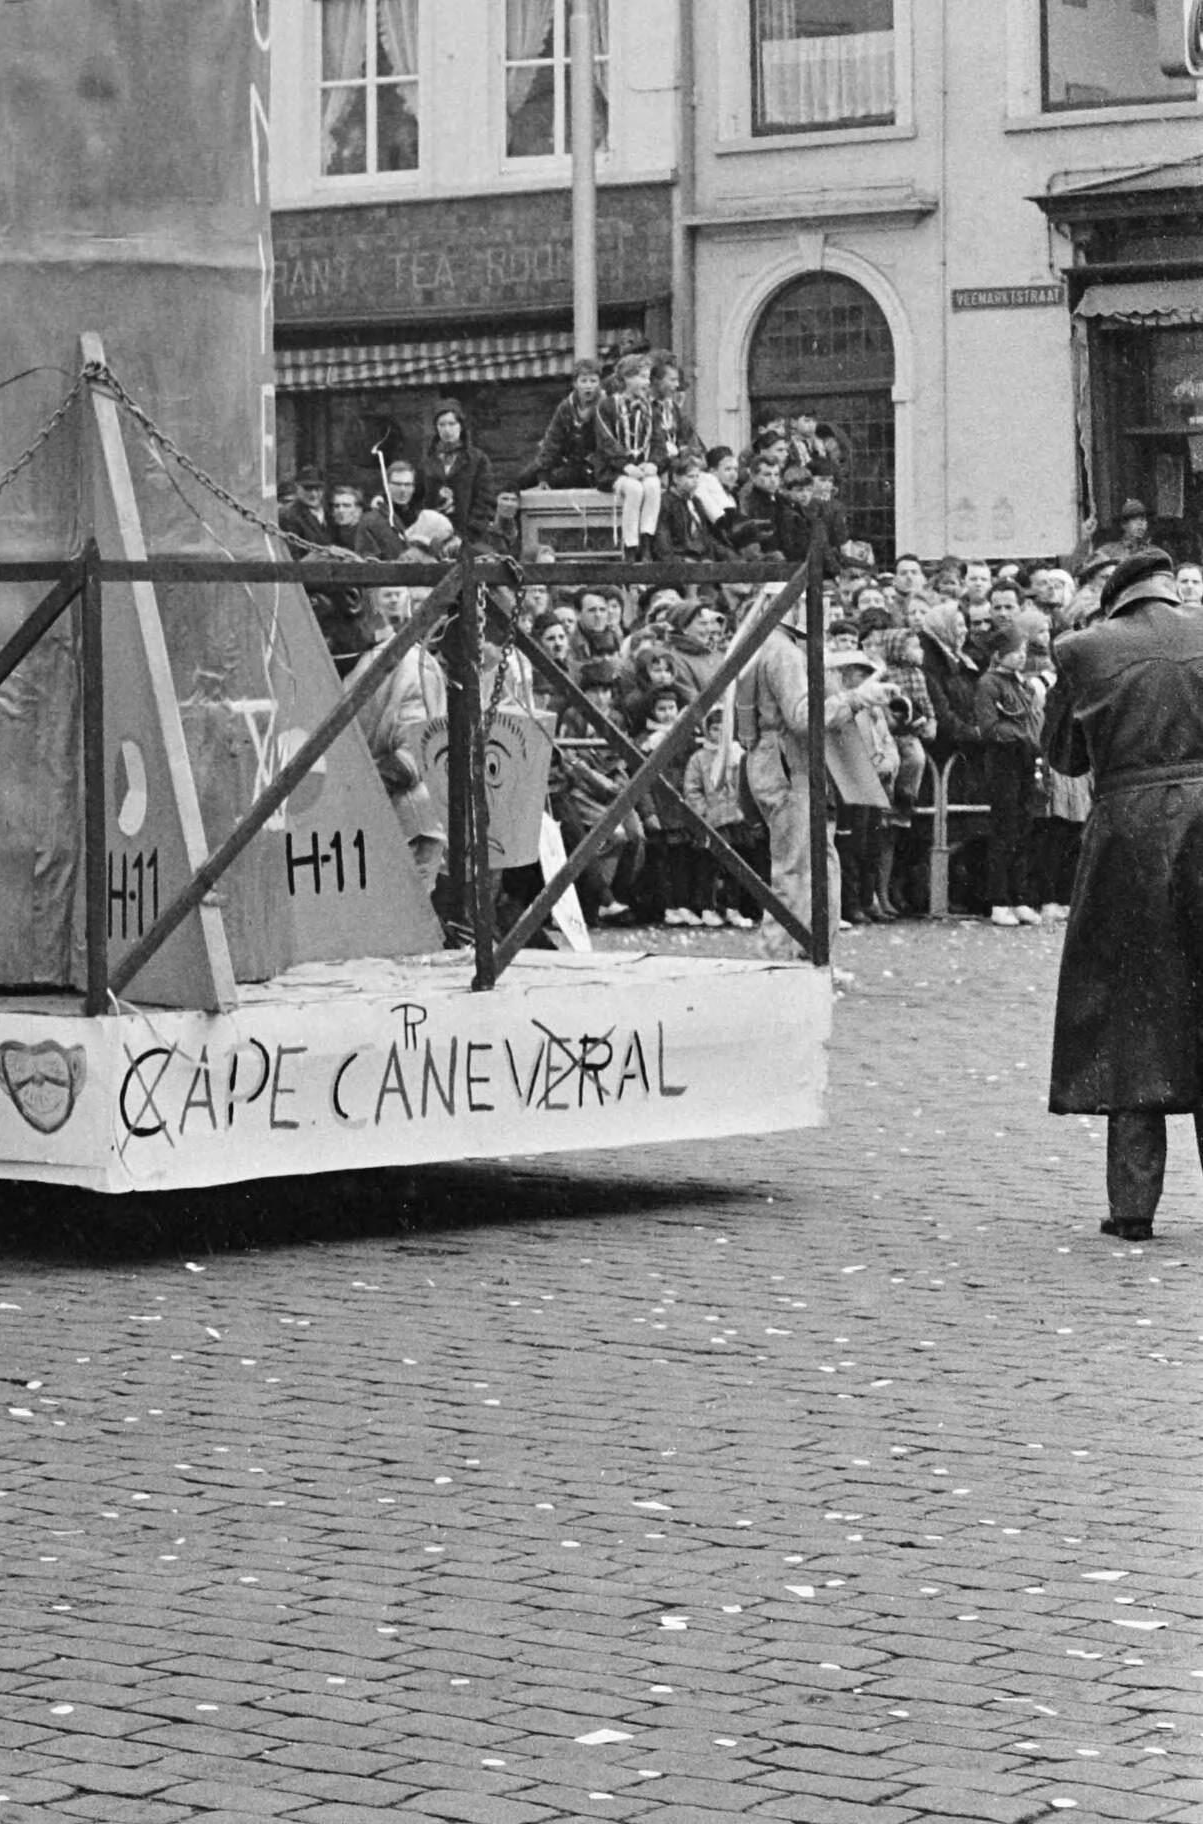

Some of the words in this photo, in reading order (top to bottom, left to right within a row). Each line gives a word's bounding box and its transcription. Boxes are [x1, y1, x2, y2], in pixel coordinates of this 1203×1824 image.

[956, 288, 1061, 307] VEEMARKTSTRAAT
[108, 847, 159, 939] H-11
[286, 829, 366, 896] H-11
